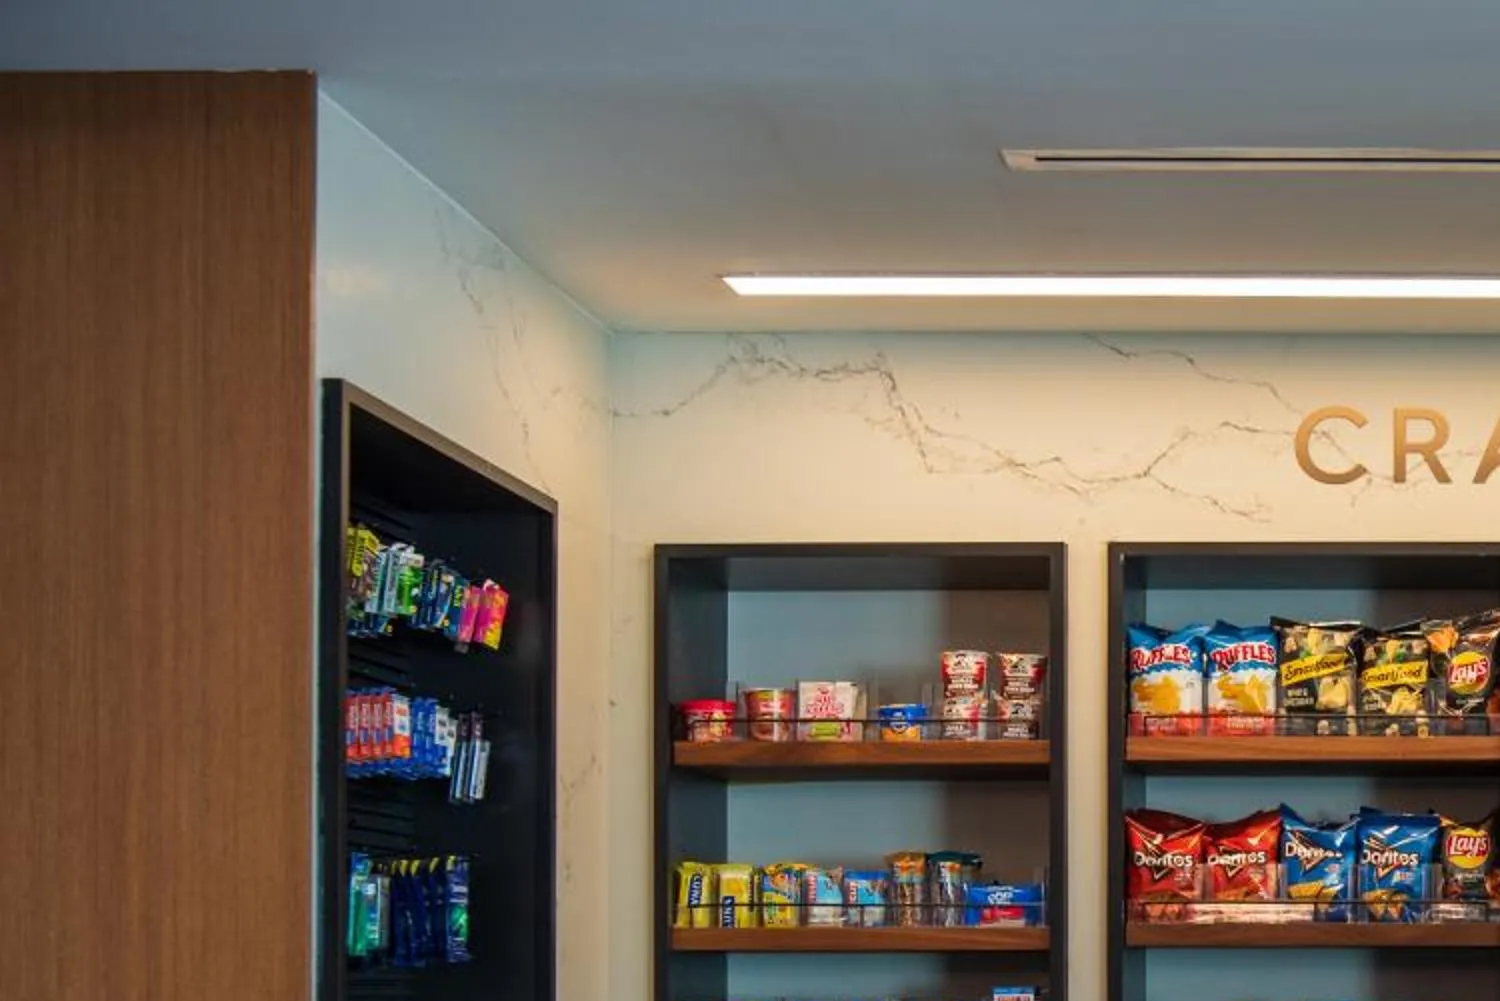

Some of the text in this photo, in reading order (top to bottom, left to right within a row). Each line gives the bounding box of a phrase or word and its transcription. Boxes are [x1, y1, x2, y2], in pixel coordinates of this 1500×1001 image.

[1130, 643, 1192, 671] RUFFLES
[1211, 642, 1276, 672] RUFFLES
[1134, 851, 1194, 868] Doritos
[1207, 850, 1266, 865] Doritos
[1361, 848, 1420, 866] Doritos
